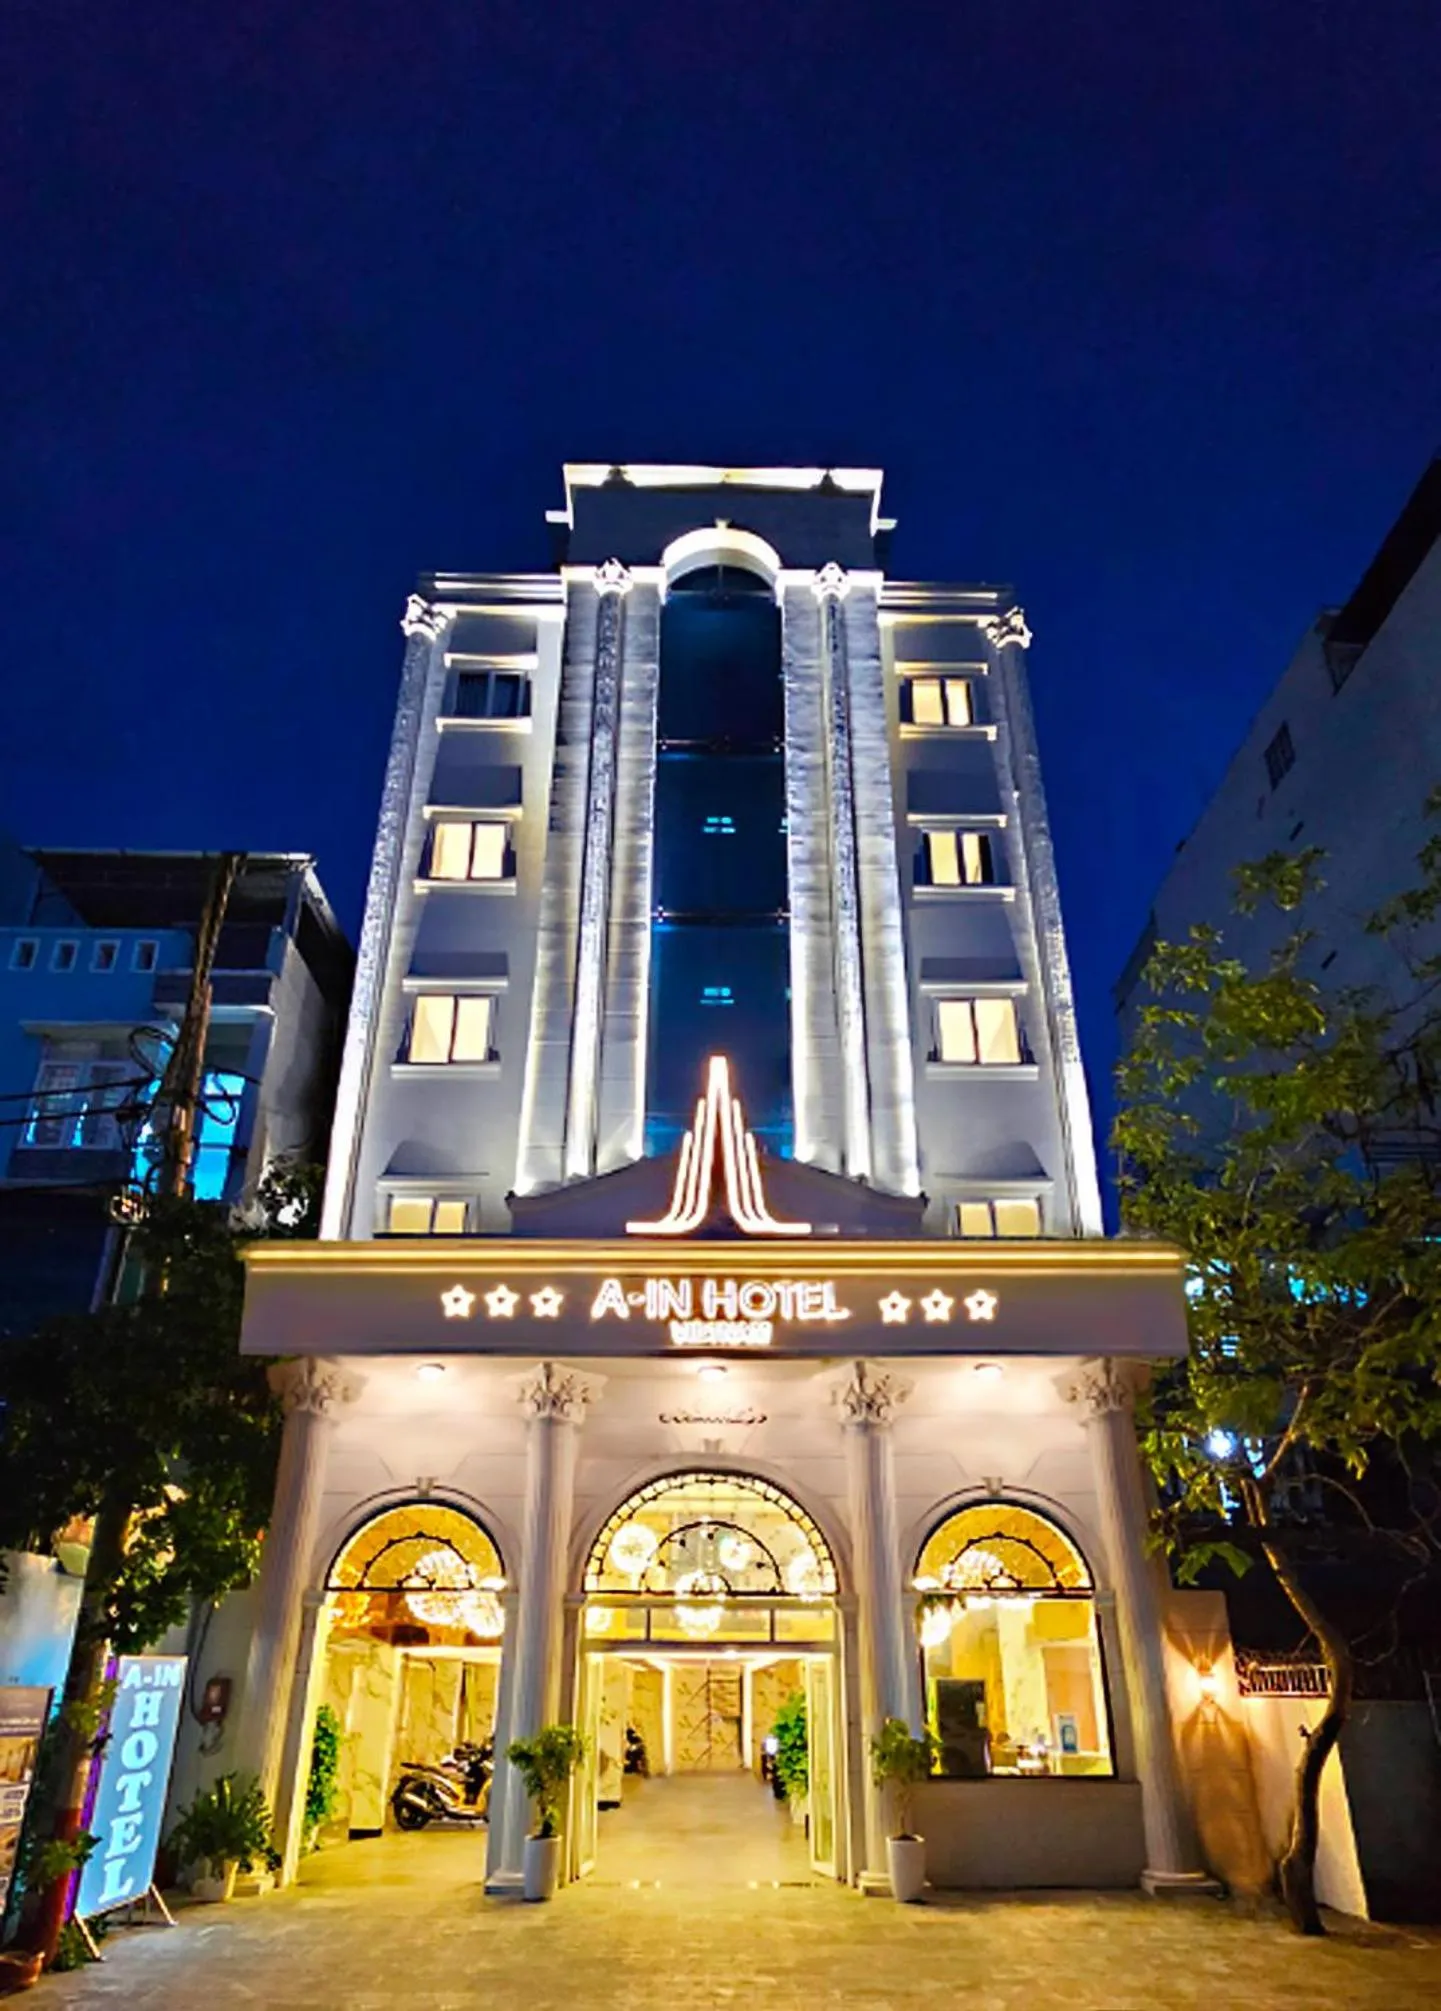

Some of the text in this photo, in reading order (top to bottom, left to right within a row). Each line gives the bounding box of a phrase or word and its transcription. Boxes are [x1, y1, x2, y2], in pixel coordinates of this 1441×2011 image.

[590, 1278, 851, 1321] A-IN HOTEL
[123, 1662, 180, 1690] A-IN
[97, 1690, 164, 1904] HOTEL
